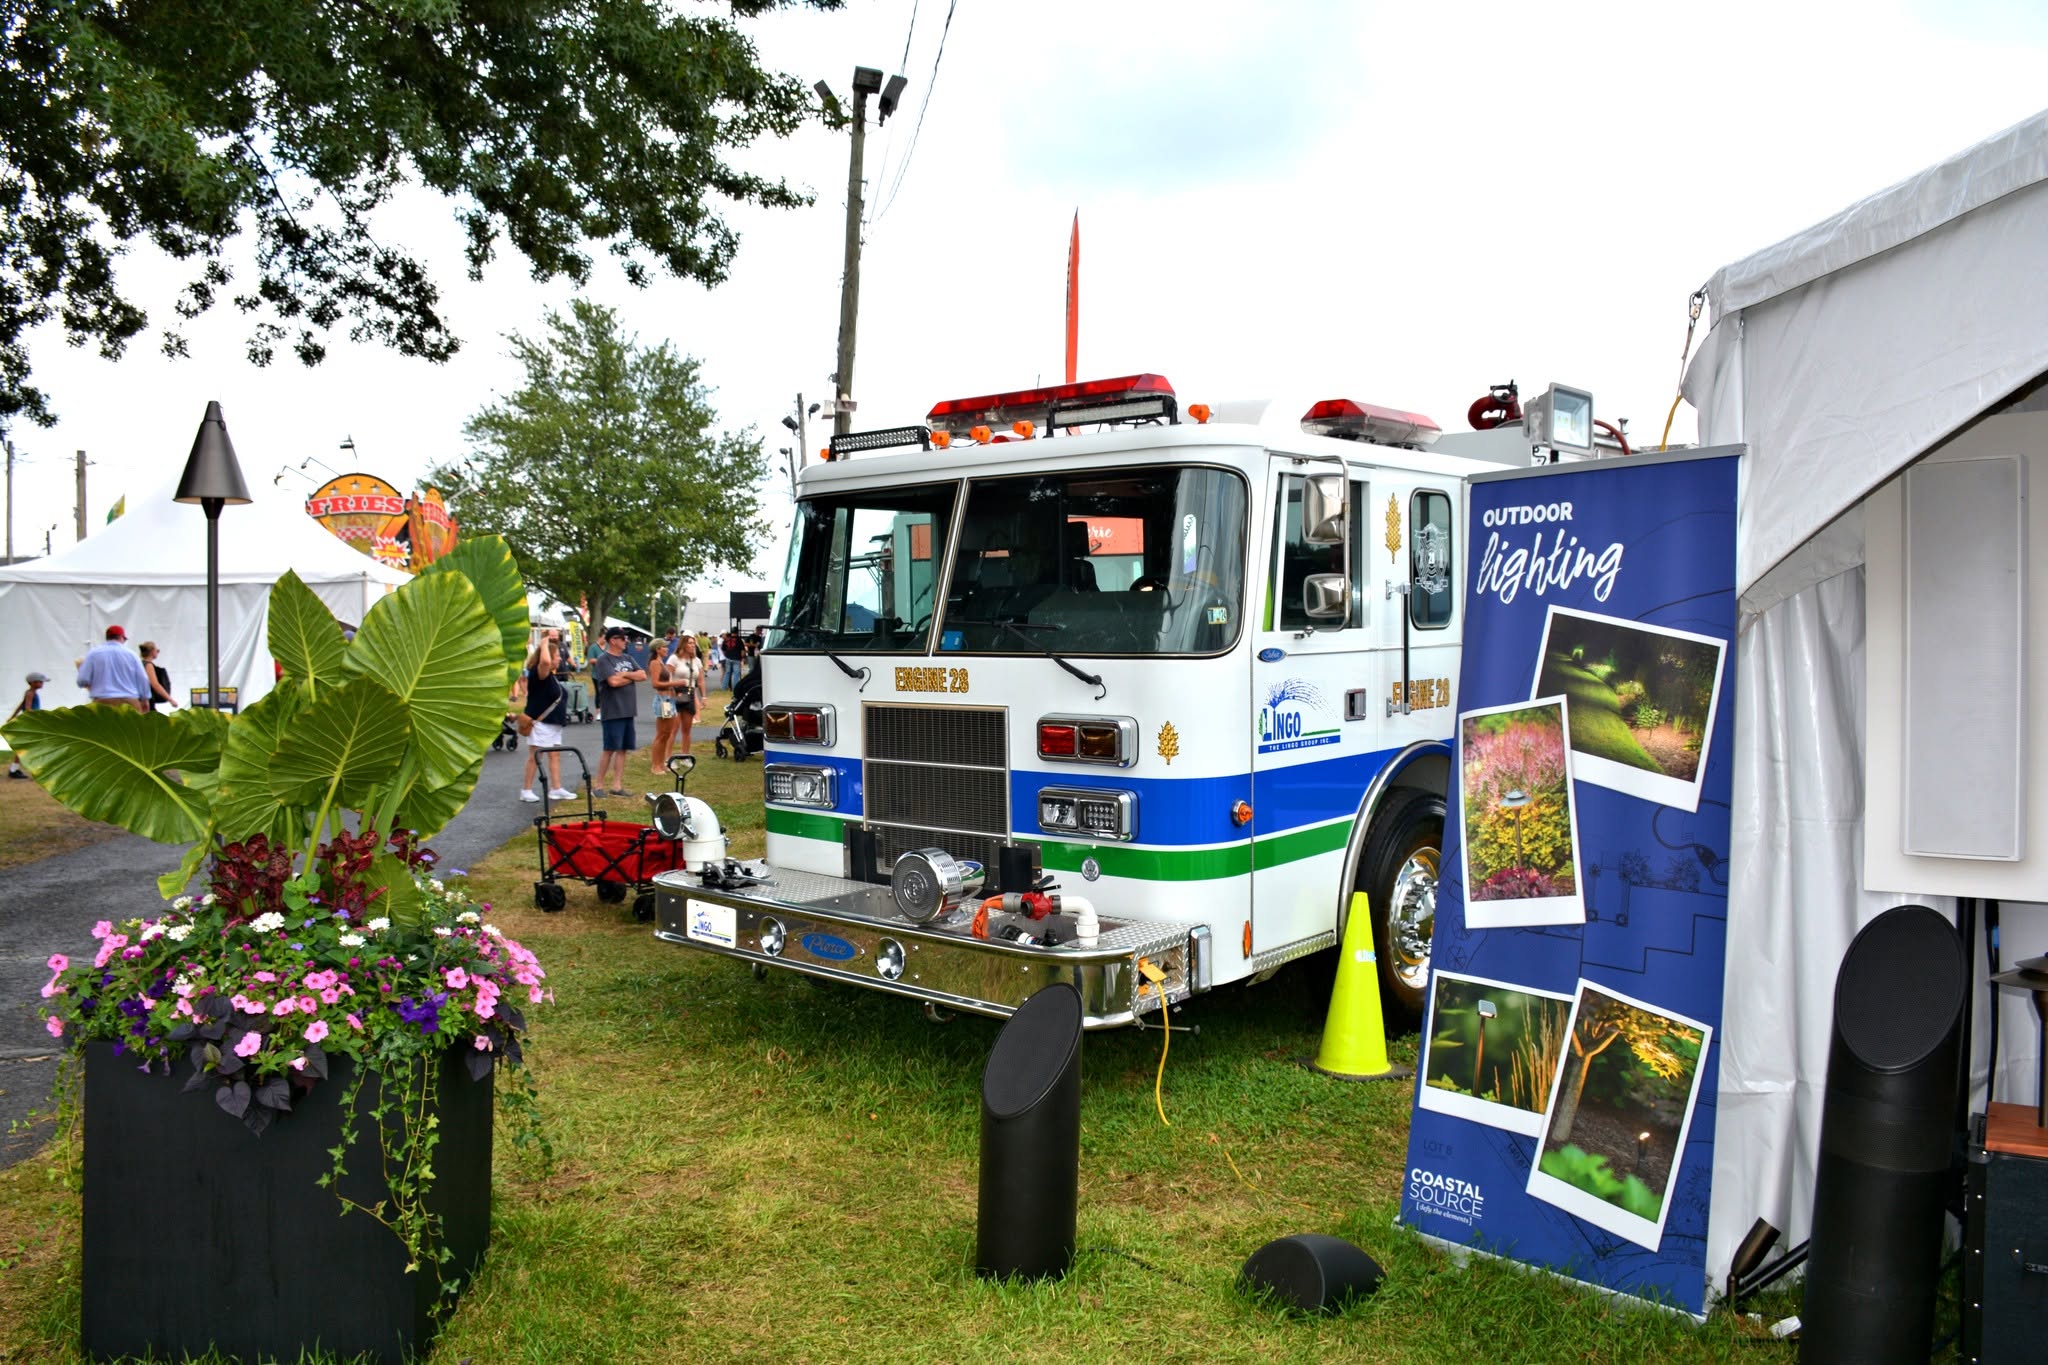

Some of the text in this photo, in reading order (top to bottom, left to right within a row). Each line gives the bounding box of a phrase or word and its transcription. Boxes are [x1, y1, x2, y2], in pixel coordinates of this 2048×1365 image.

[309, 495, 404, 518] FRIES
[1482, 502, 1573, 528] OUTDOOR
[1476, 528, 1624, 604] lighting
[895, 667, 970, 694] ENGINE 28
[1392, 678, 1450, 713] EGINE 28
[1262, 708, 1301, 742] LINGO
[1269, 743, 1280, 751] THE
[1281, 741, 1299, 750] LINGO
[1300, 739, 1318, 748] GROUP
[809, 934, 849, 956] Pierce
[1423, 1138, 1444, 1153] LOT
[1411, 1168, 1484, 1201] COASTAL
[1409, 1182, 1483, 1217] SOURCE
[1433, 1207, 1442, 1216] the
